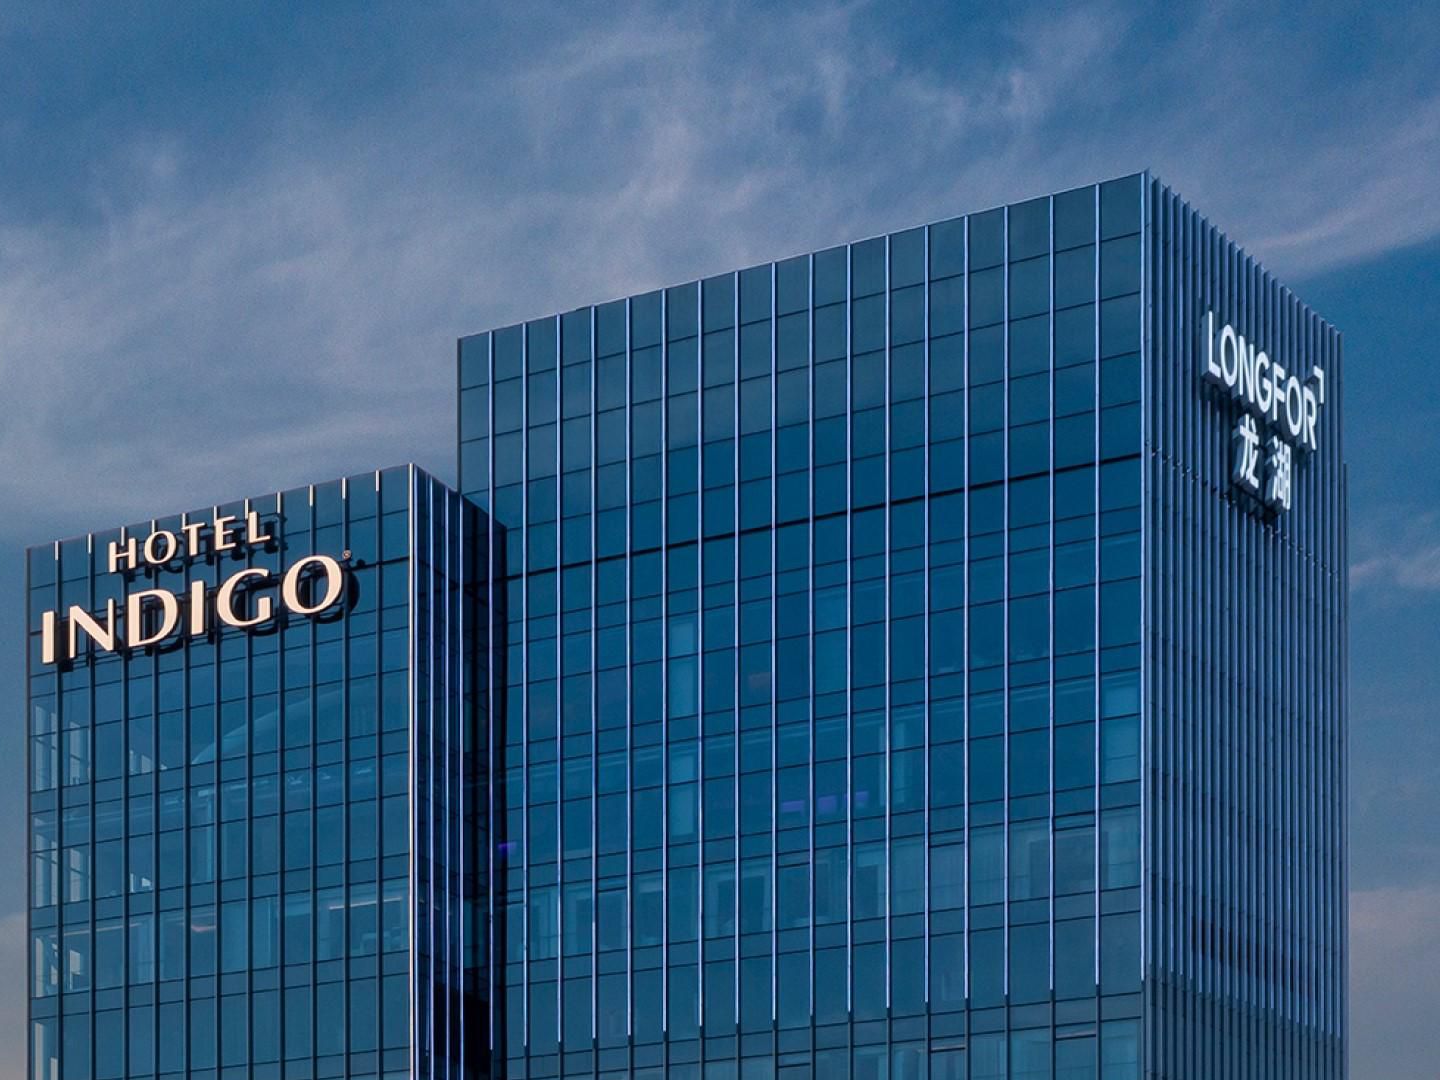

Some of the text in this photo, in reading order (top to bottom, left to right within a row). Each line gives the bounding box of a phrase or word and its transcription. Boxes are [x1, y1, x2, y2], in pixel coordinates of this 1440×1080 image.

[1208, 310, 1318, 451] LONGFOR
[1239, 412, 1291, 511] 龙湖
[108, 510, 271, 573] HOTEL
[41, 554, 343, 665] INDIGO
